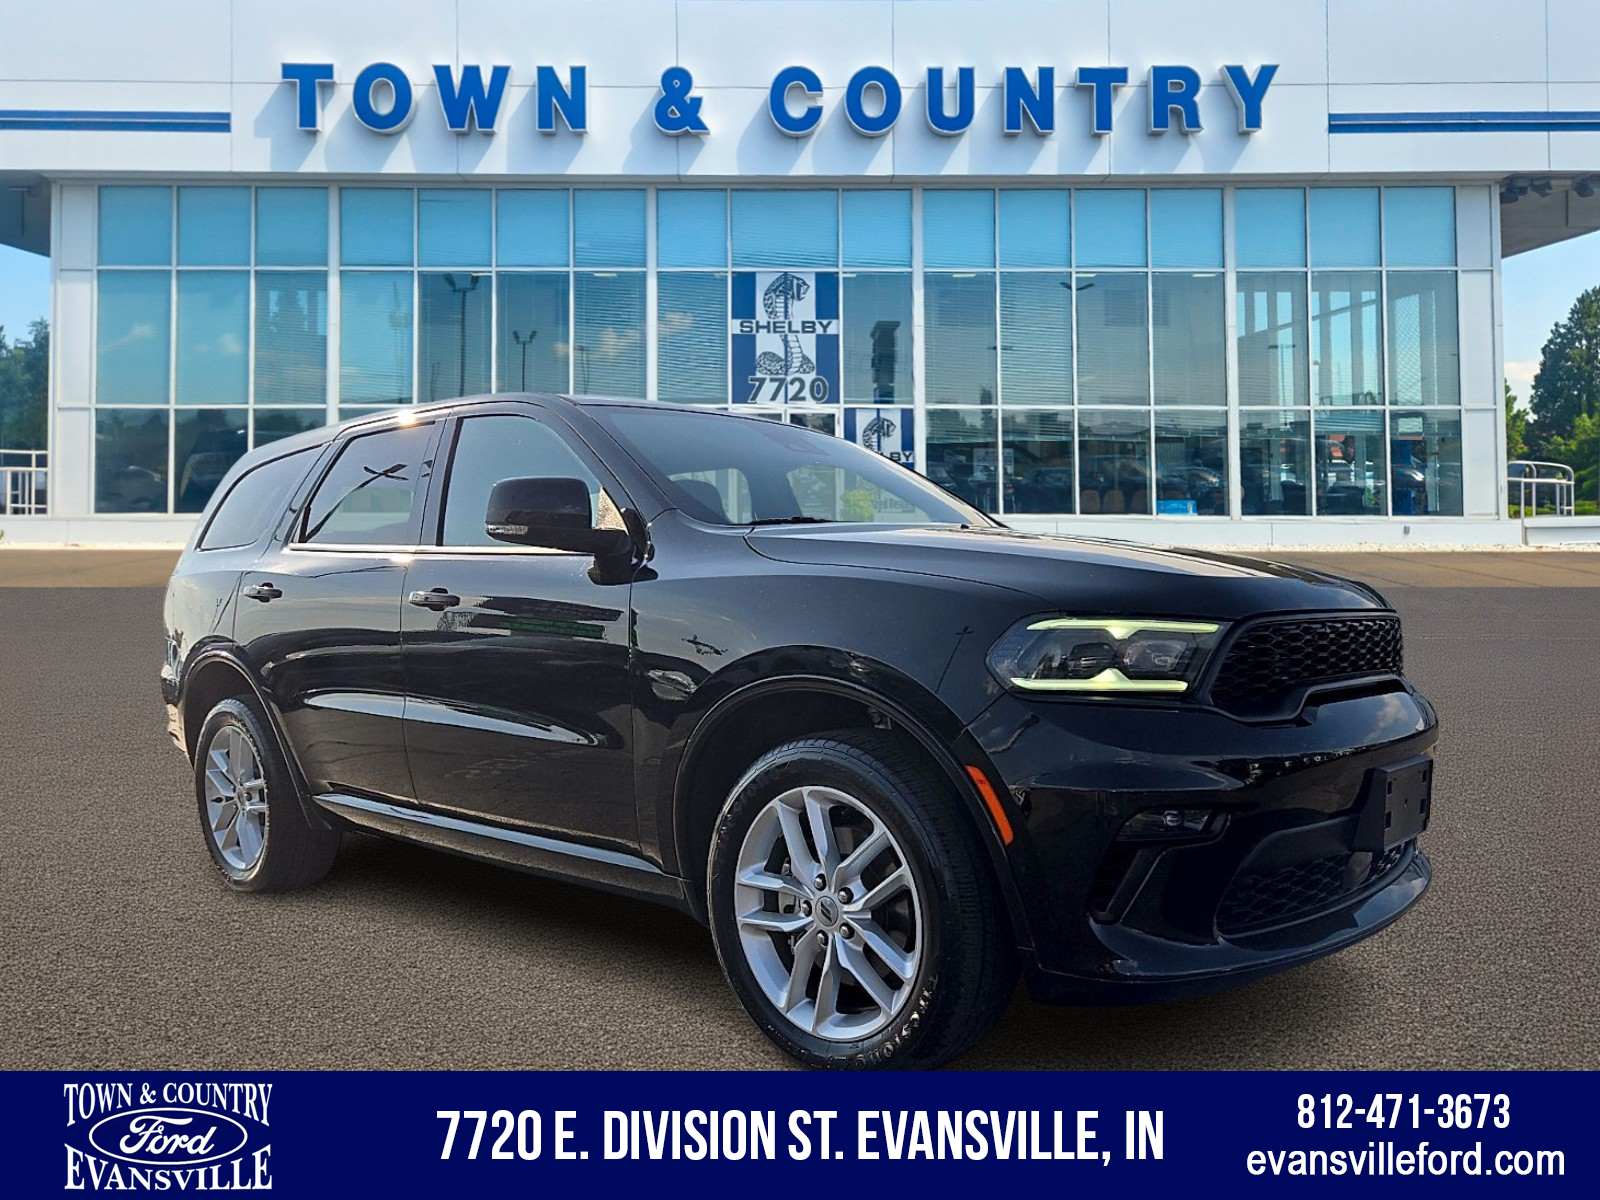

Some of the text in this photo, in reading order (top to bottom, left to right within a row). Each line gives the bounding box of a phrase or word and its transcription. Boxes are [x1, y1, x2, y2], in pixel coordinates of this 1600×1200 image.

[281, 62, 1279, 137] TOWN & COUNTRY
[739, 320, 832, 334] SHELBY
[748, 376, 829, 403] 7720
